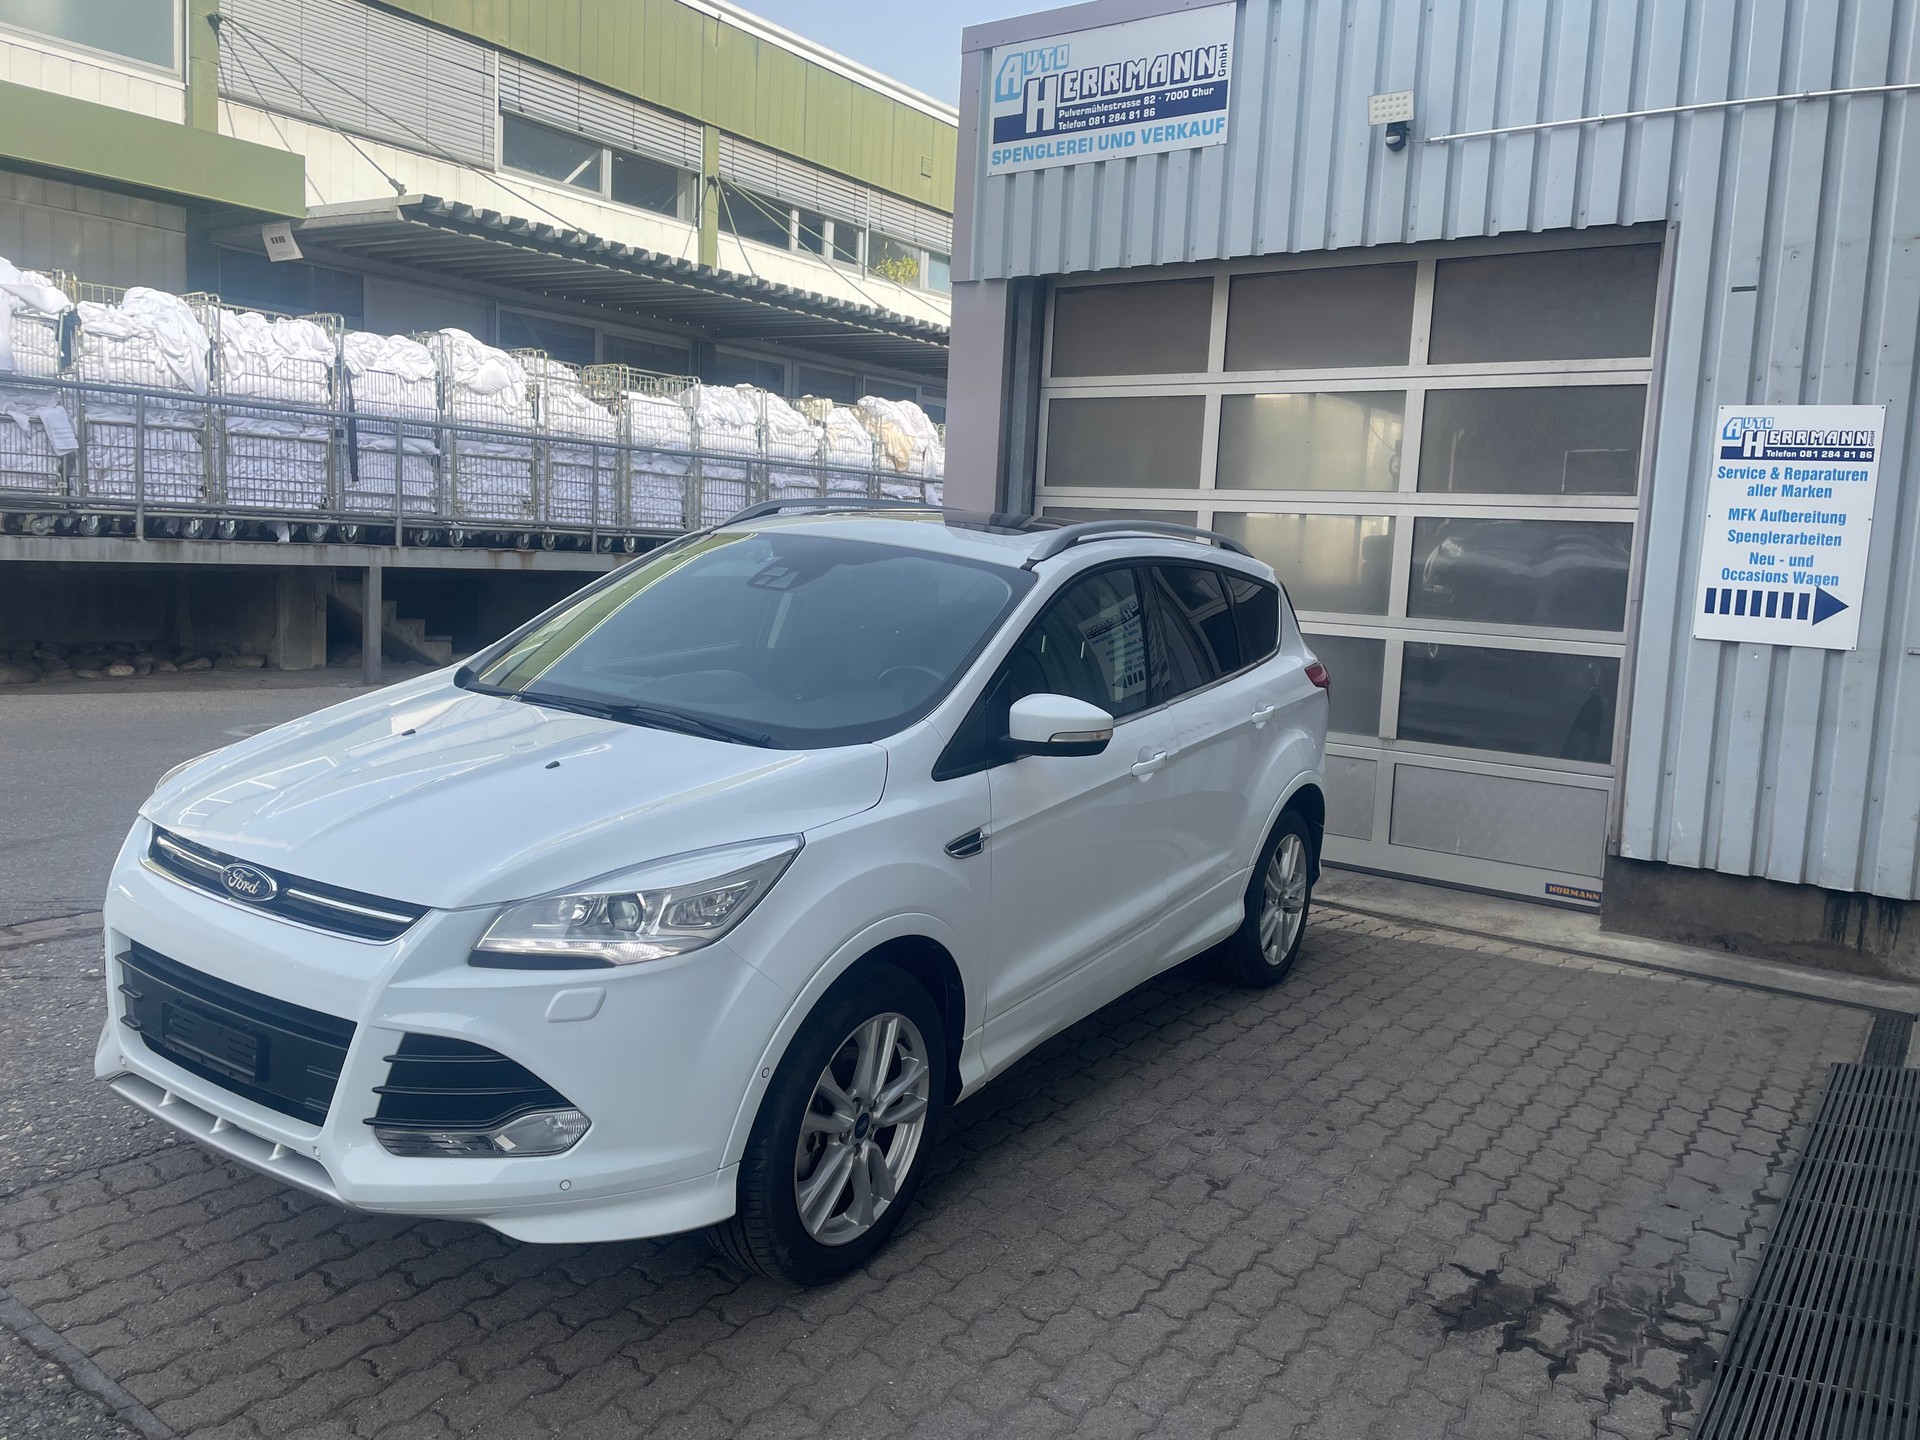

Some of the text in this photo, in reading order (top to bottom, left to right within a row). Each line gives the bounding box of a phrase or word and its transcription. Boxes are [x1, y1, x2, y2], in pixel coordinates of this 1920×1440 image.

[994, 43, 1070, 103] AUTO
[1023, 43, 1228, 134] HERRMANN GmbH
[1058, 98, 1141, 119] Pulvermühlestrasse
[1143, 95, 1156, 105] 82
[1164, 89, 1189, 102] 7000
[1191, 87, 1215, 98] Chur
[1058, 107, 1156, 131] Telefon 081 284 81 86
[991, 116, 1226, 166] SPENGLEREI UND VERKAUF
[1722, 416, 1775, 440] AUTO
[1742, 429, 1869, 458] HERRMANN
[1766, 449, 1873, 459] Telefon 081 284 81 86
[1717, 466, 1868, 482] Service & Reparaturen
[1747, 484, 1832, 498] aller Marken
[1728, 508, 1847, 526] MFK Aufbereitung
[1727, 529, 1842, 546] Spenglerarbeiten
[1749, 552, 1775, 566] Neu
[1788, 555, 1815, 567] und
[1721, 567, 1839, 586] Occasions Wagen
[228, 867, 260, 895] Ford
